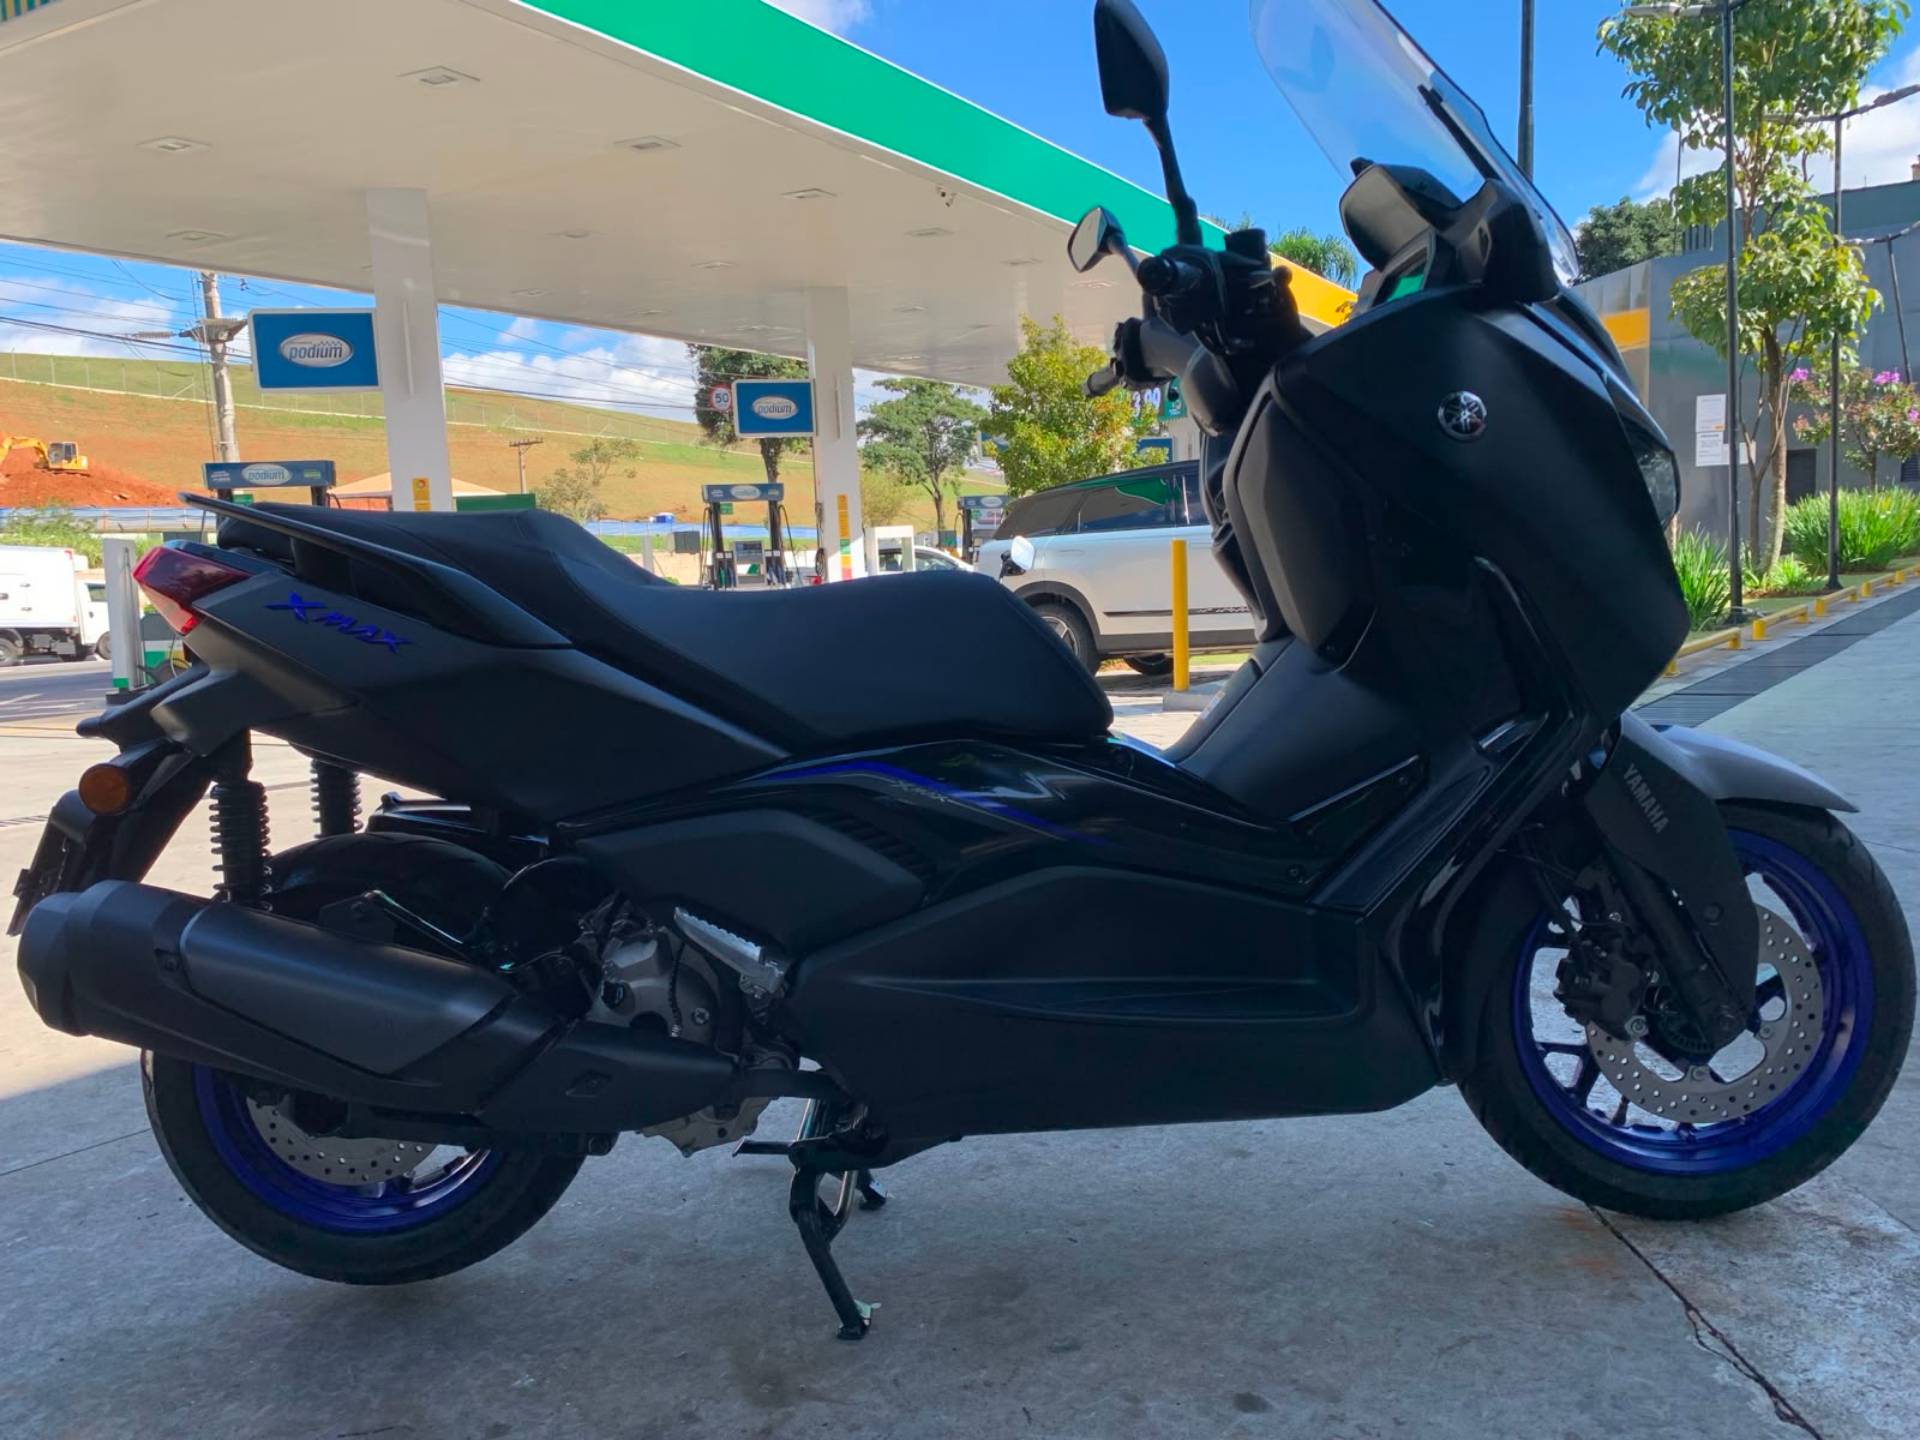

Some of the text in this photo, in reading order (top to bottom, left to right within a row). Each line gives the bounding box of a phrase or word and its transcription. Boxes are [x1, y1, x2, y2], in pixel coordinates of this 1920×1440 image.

[288, 344, 342, 364] podium
[715, 392, 729, 404] 50
[1623, 762, 1669, 834] YAMAHA
